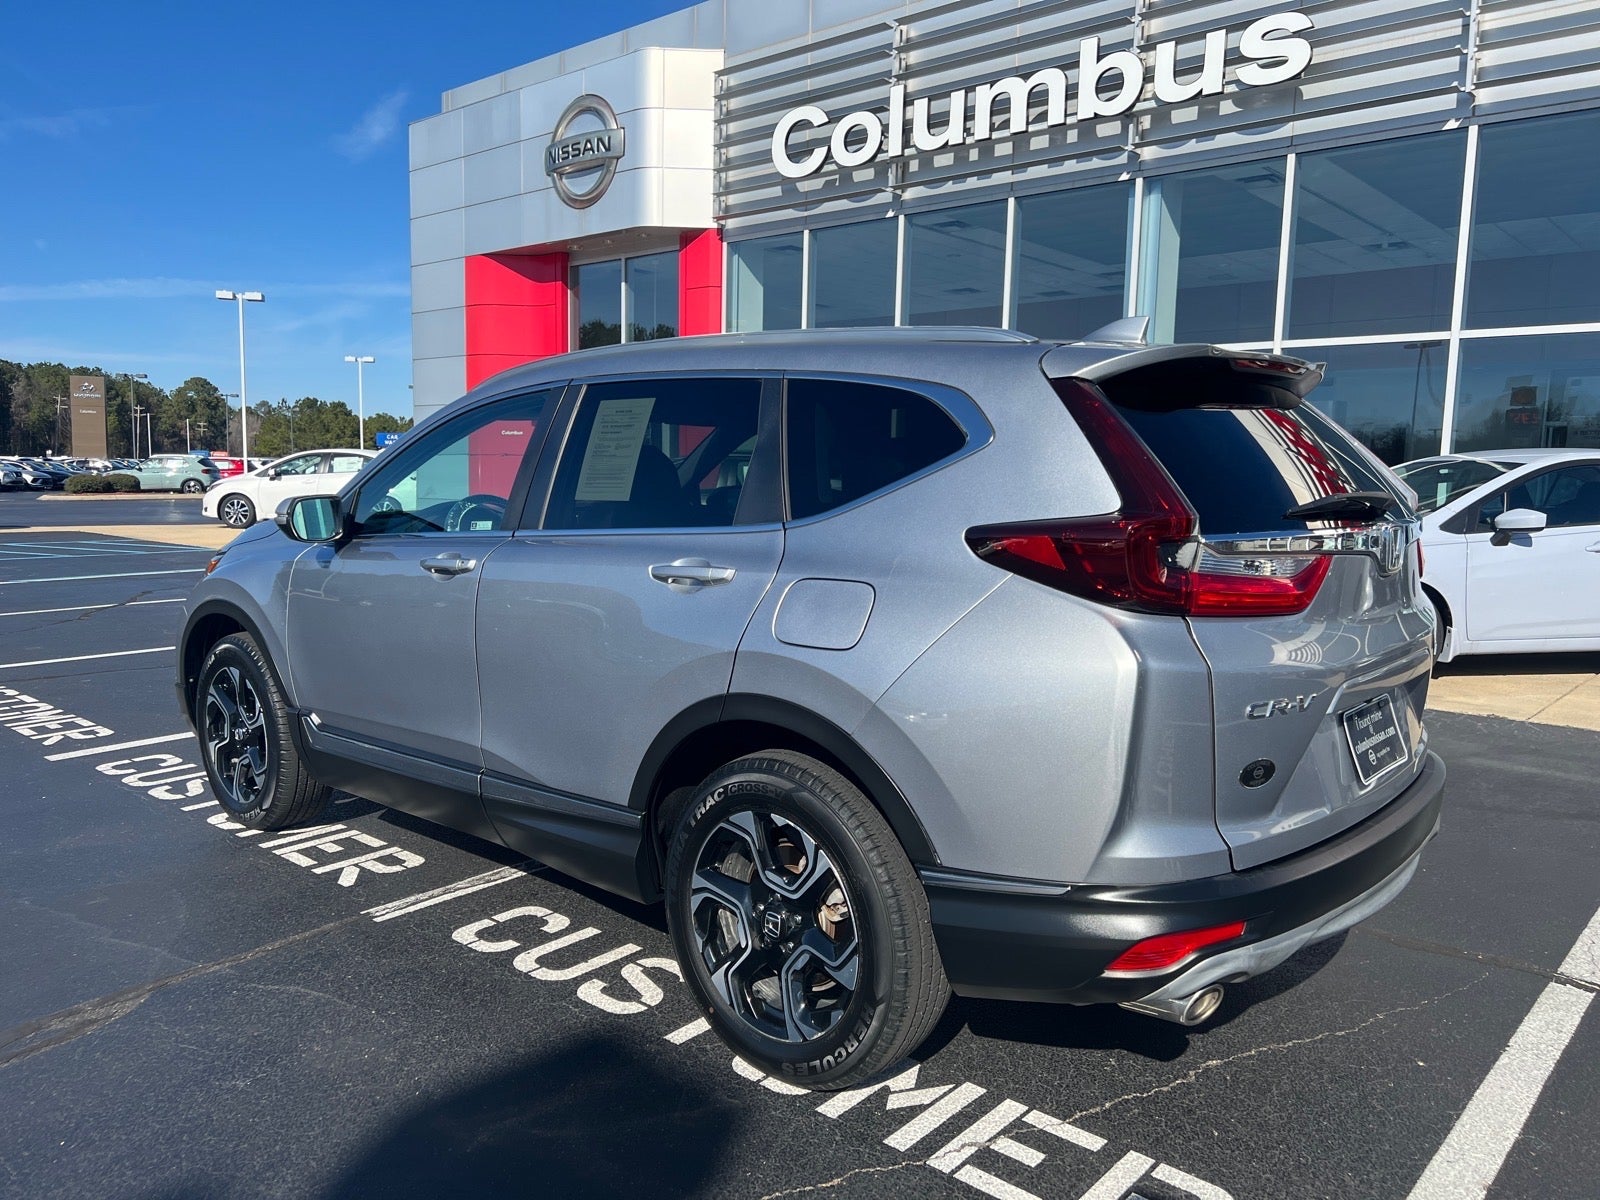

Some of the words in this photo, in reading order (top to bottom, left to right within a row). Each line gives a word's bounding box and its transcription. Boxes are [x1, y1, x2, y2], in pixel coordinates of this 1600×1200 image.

[771, 11, 1313, 178] Columbus
[548, 135, 612, 165] NISSAN
[1245, 694, 1317, 719] CR-V
[1355, 726, 1396, 754] columbusnissan.com
